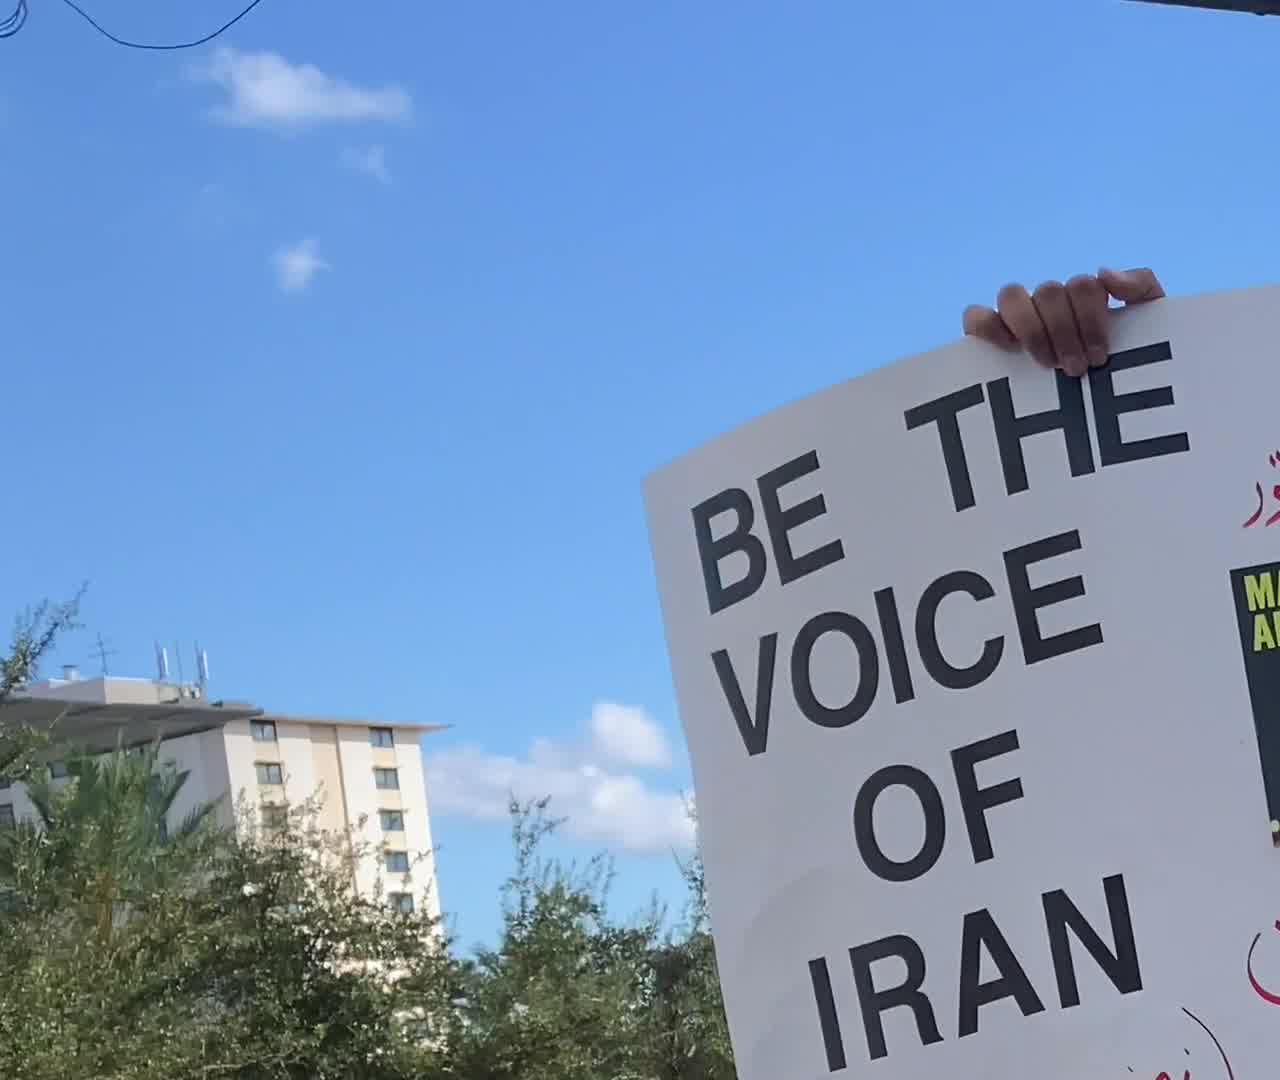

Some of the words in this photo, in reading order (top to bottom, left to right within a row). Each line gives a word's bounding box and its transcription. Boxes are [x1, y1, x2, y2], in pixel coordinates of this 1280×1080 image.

[691, 450, 844, 614] BE
[904, 341, 1190, 512] THE
[711, 529, 1103, 756] VOICE
[853, 729, 1024, 882] OF
[807, 873, 1142, 1072] IRAN
